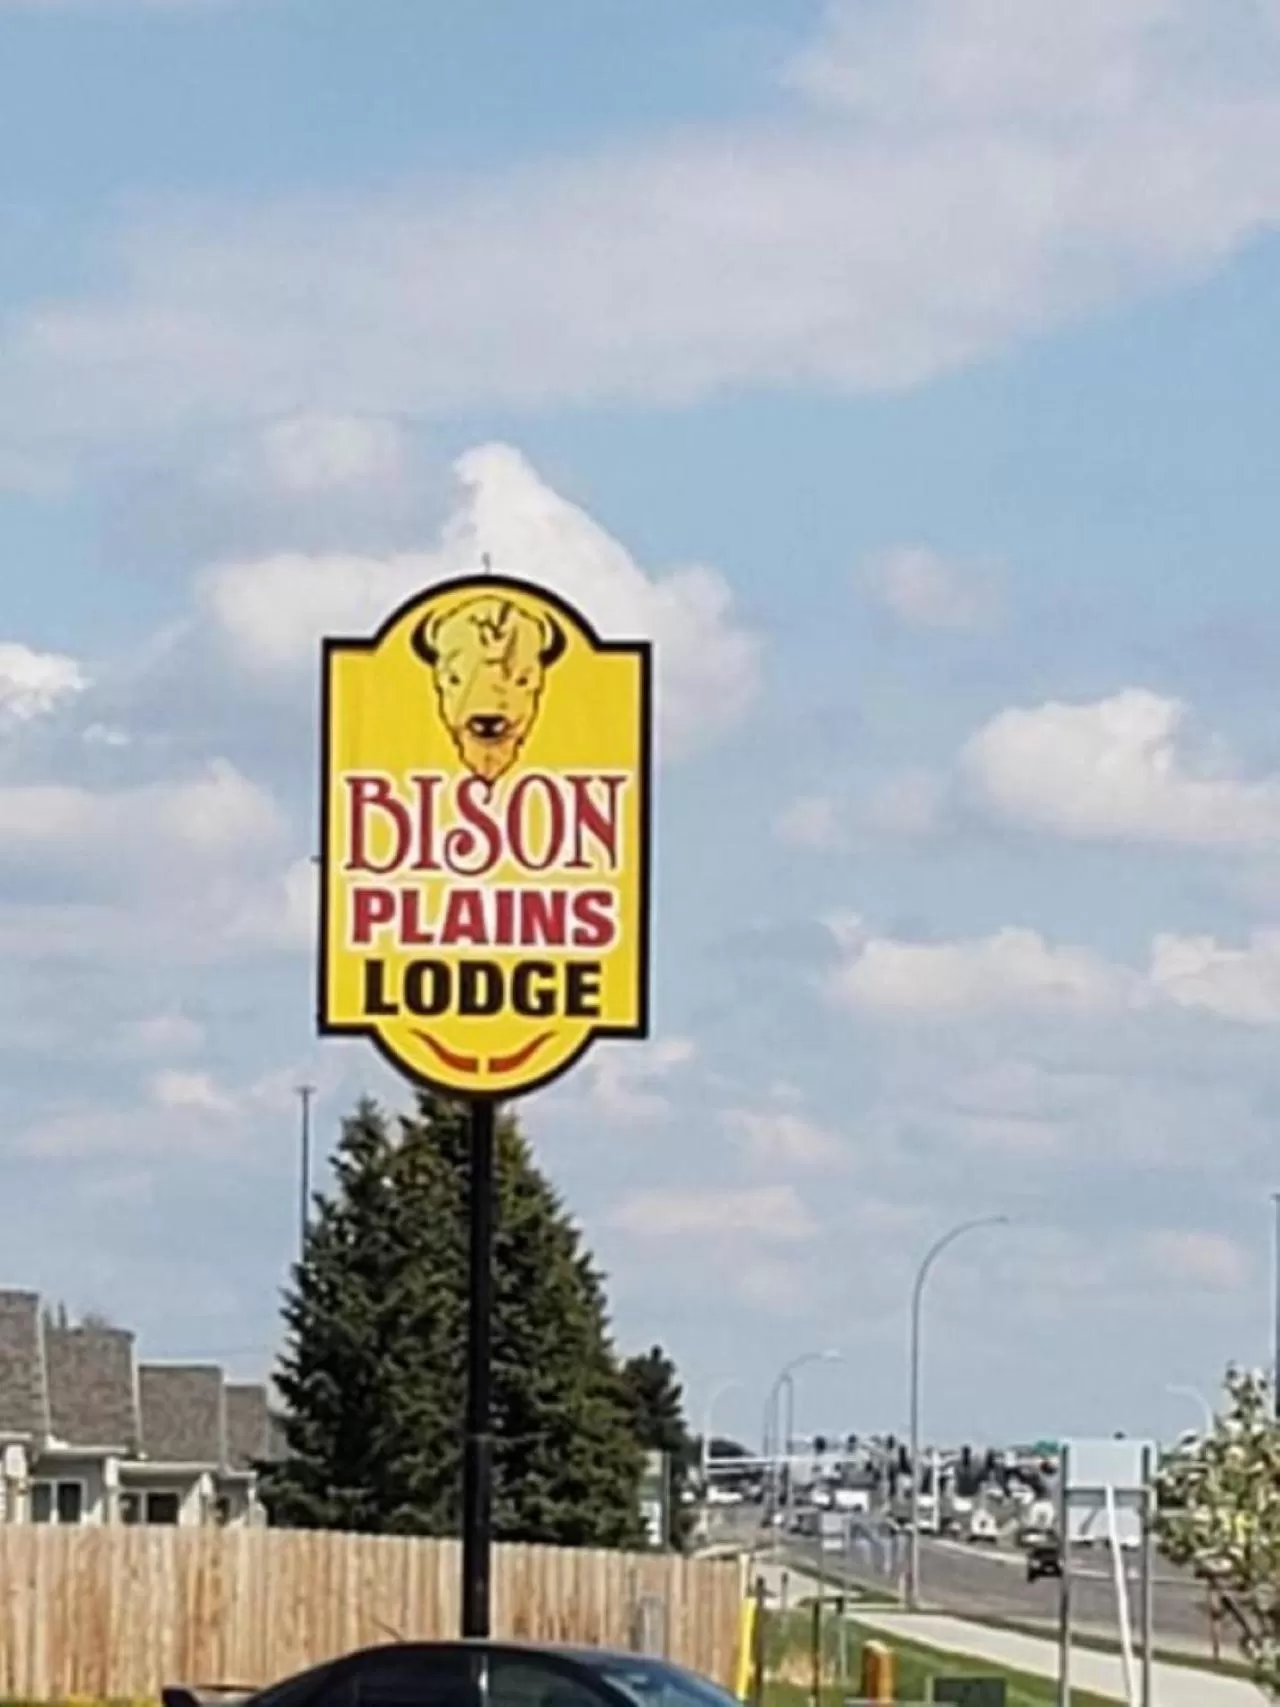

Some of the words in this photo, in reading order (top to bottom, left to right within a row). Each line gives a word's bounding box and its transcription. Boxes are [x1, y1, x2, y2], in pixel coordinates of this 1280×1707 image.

[343, 773, 628, 877] BISON
[351, 887, 616, 948] PLAINS
[363, 957, 602, 1018] LODGE
